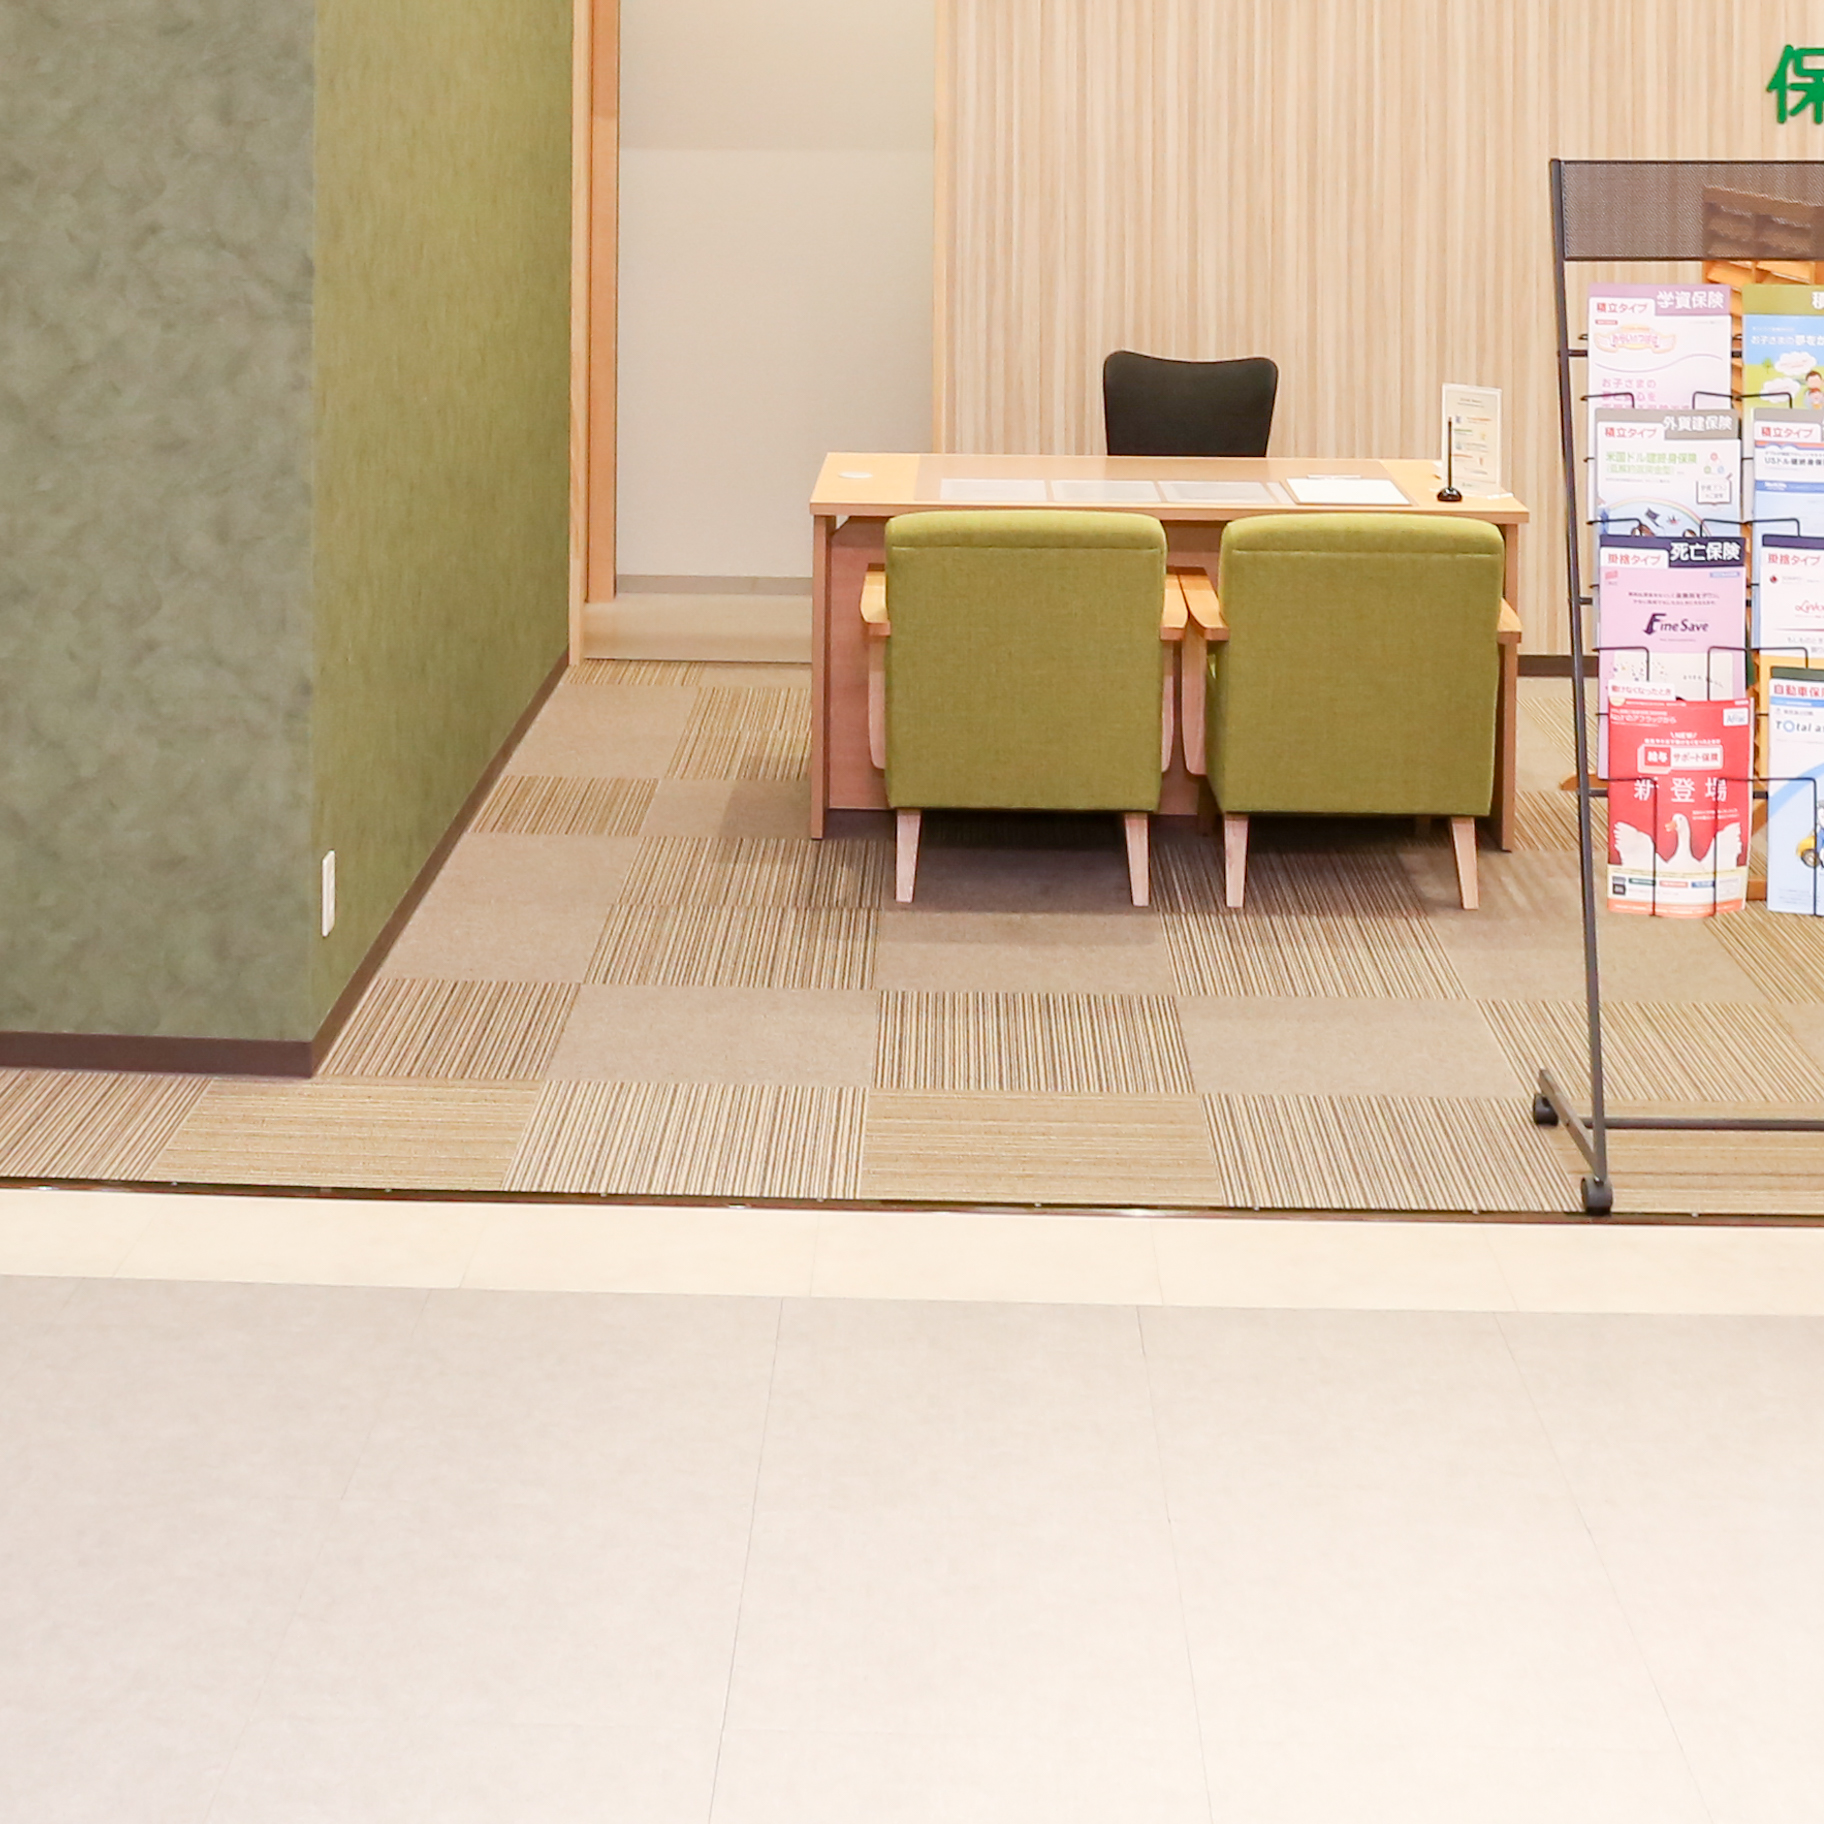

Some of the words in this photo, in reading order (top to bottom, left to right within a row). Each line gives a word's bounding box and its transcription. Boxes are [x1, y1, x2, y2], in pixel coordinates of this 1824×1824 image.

[1656, 290, 1724, 309] 学資保険
[1596, 302, 1648, 314] 積立タイプ
[1602, 378, 1657, 388] お子さまの
[1663, 415, 1733, 432] 外貨建保険
[1604, 426, 1658, 439] 積立タイプ
[1761, 426, 1814, 439] 積立タイプ
[1669, 541, 1741, 562] 死亡保険
[1607, 552, 1662, 566] 掛捨タイプ
[1767, 553, 1821, 567] 掛捨タイプ
[1611, 684, 1672, 696] 動けなくなったとき
